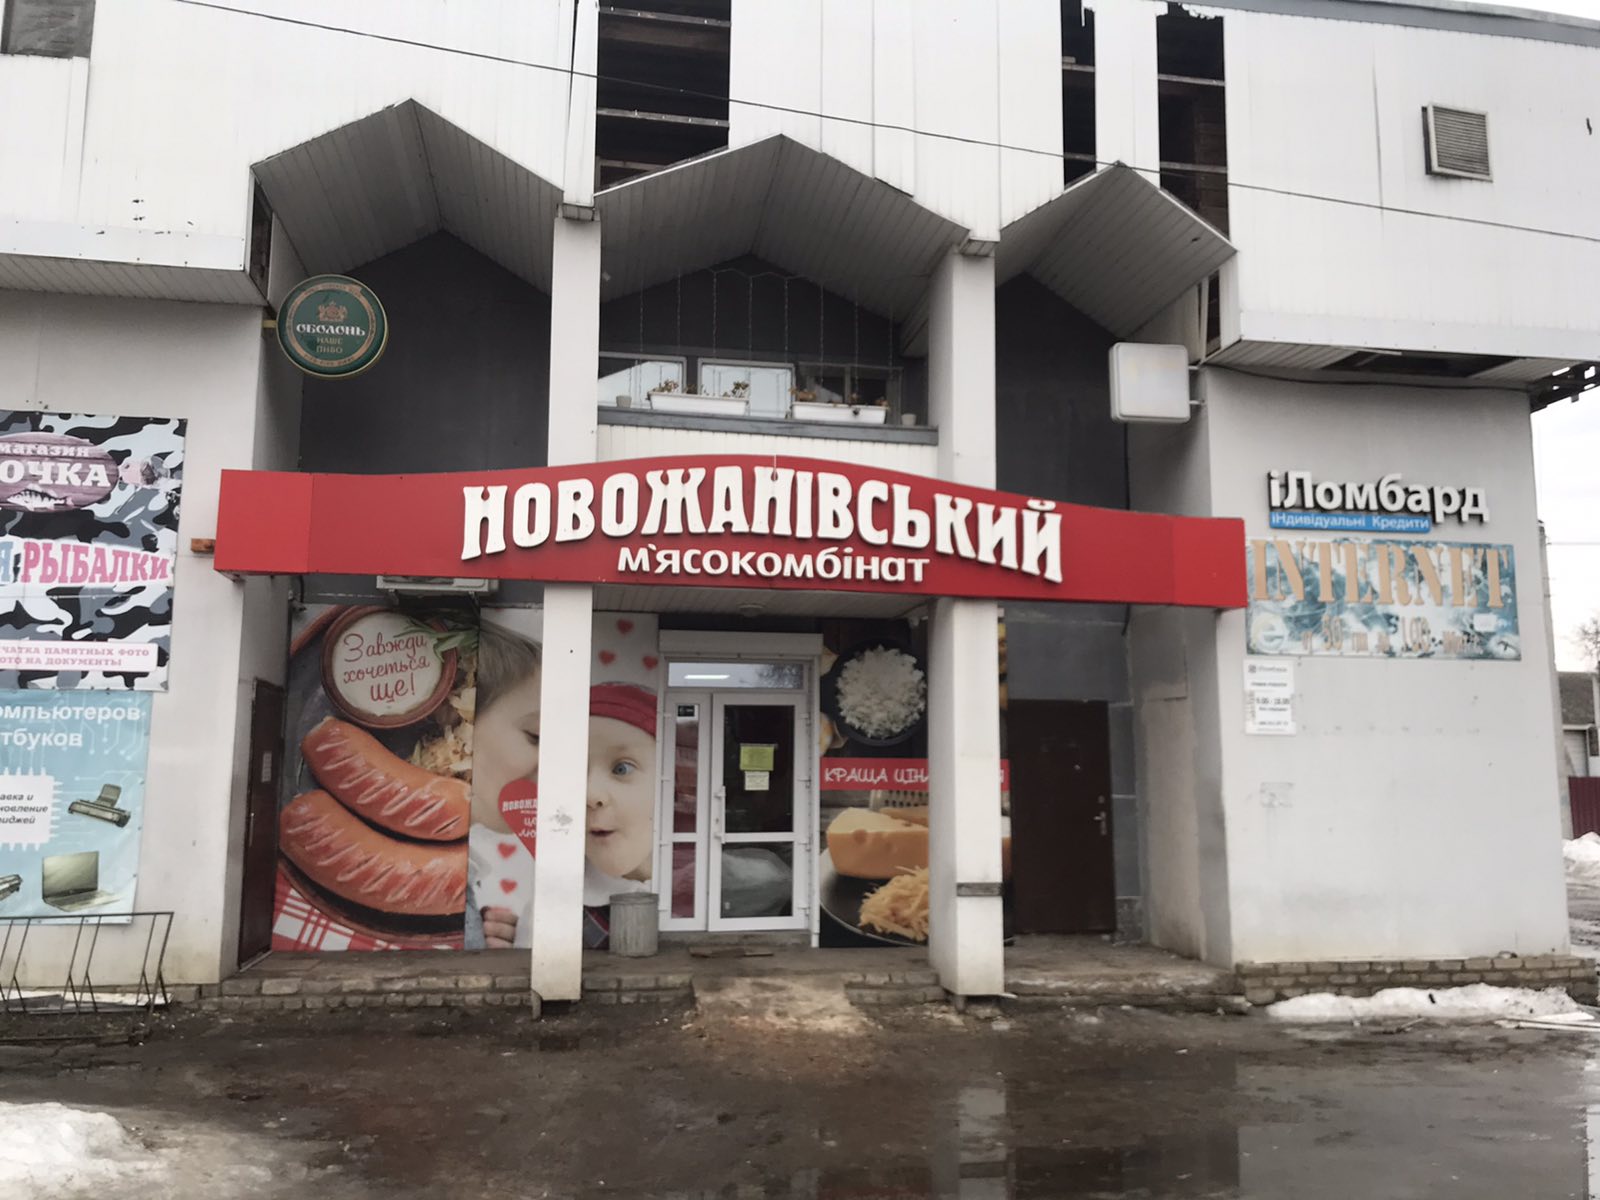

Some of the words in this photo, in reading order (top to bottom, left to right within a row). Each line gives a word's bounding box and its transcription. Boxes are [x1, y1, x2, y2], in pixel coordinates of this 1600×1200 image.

[296, 323, 366, 336] ОБОЛОНЬ
[1268, 470, 1490, 523] іЛомбард
[461, 466, 1062, 583] НОВОЖАНІВСЬКИЙ
[1372, 517, 1430, 531] Кредити
[21, 541, 170, 584] РЫБАЛКИ
[1250, 538, 1510, 608] INTERNET
[118, 648, 149, 657] ФОТО
[343, 632, 427, 662] Завжди
[45, 658, 122, 666] ДОКУМЕНТЫ
[343, 656, 430, 684] хочеться
[824, 768, 888, 784] КРАЩА
